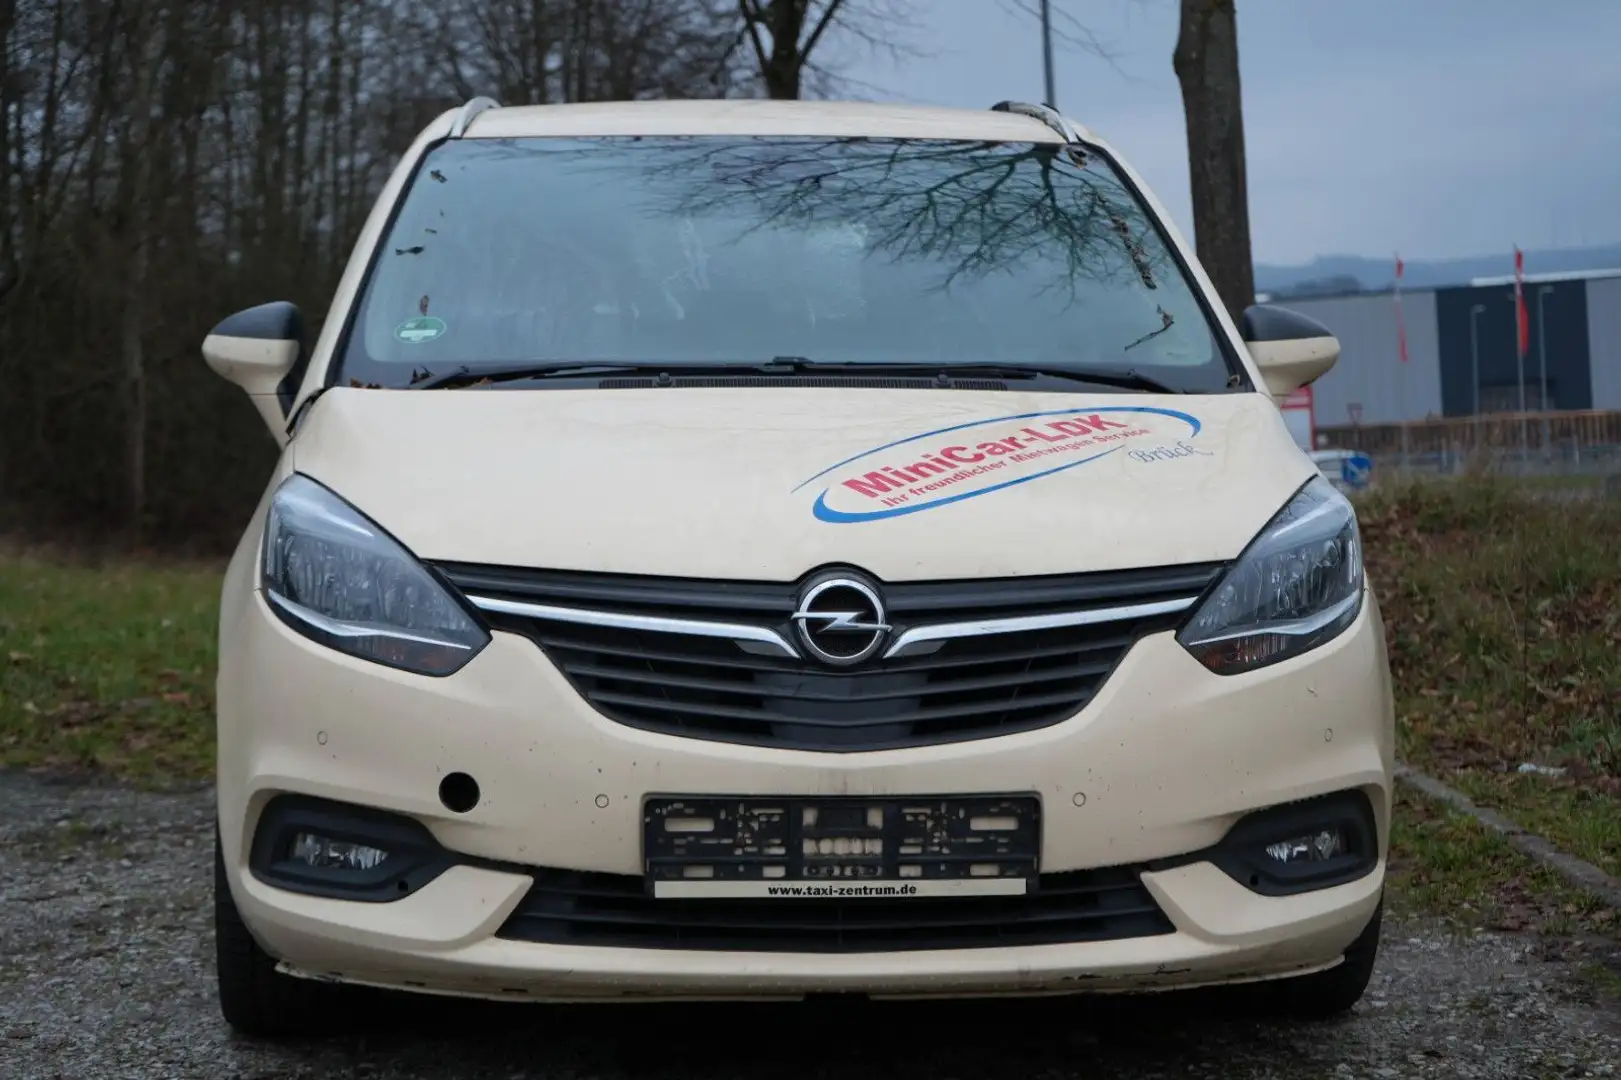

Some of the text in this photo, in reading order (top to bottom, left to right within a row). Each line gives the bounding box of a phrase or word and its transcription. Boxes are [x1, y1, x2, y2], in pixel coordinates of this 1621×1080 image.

[841, 414, 1128, 498] MiniCar-LDK
[1128, 441, 1213, 463] Brück
[881, 493, 909, 507] Ihr
[908, 459, 1007, 496] freundlicher
[768, 884, 917, 896] www.taxi-zentrum.de
